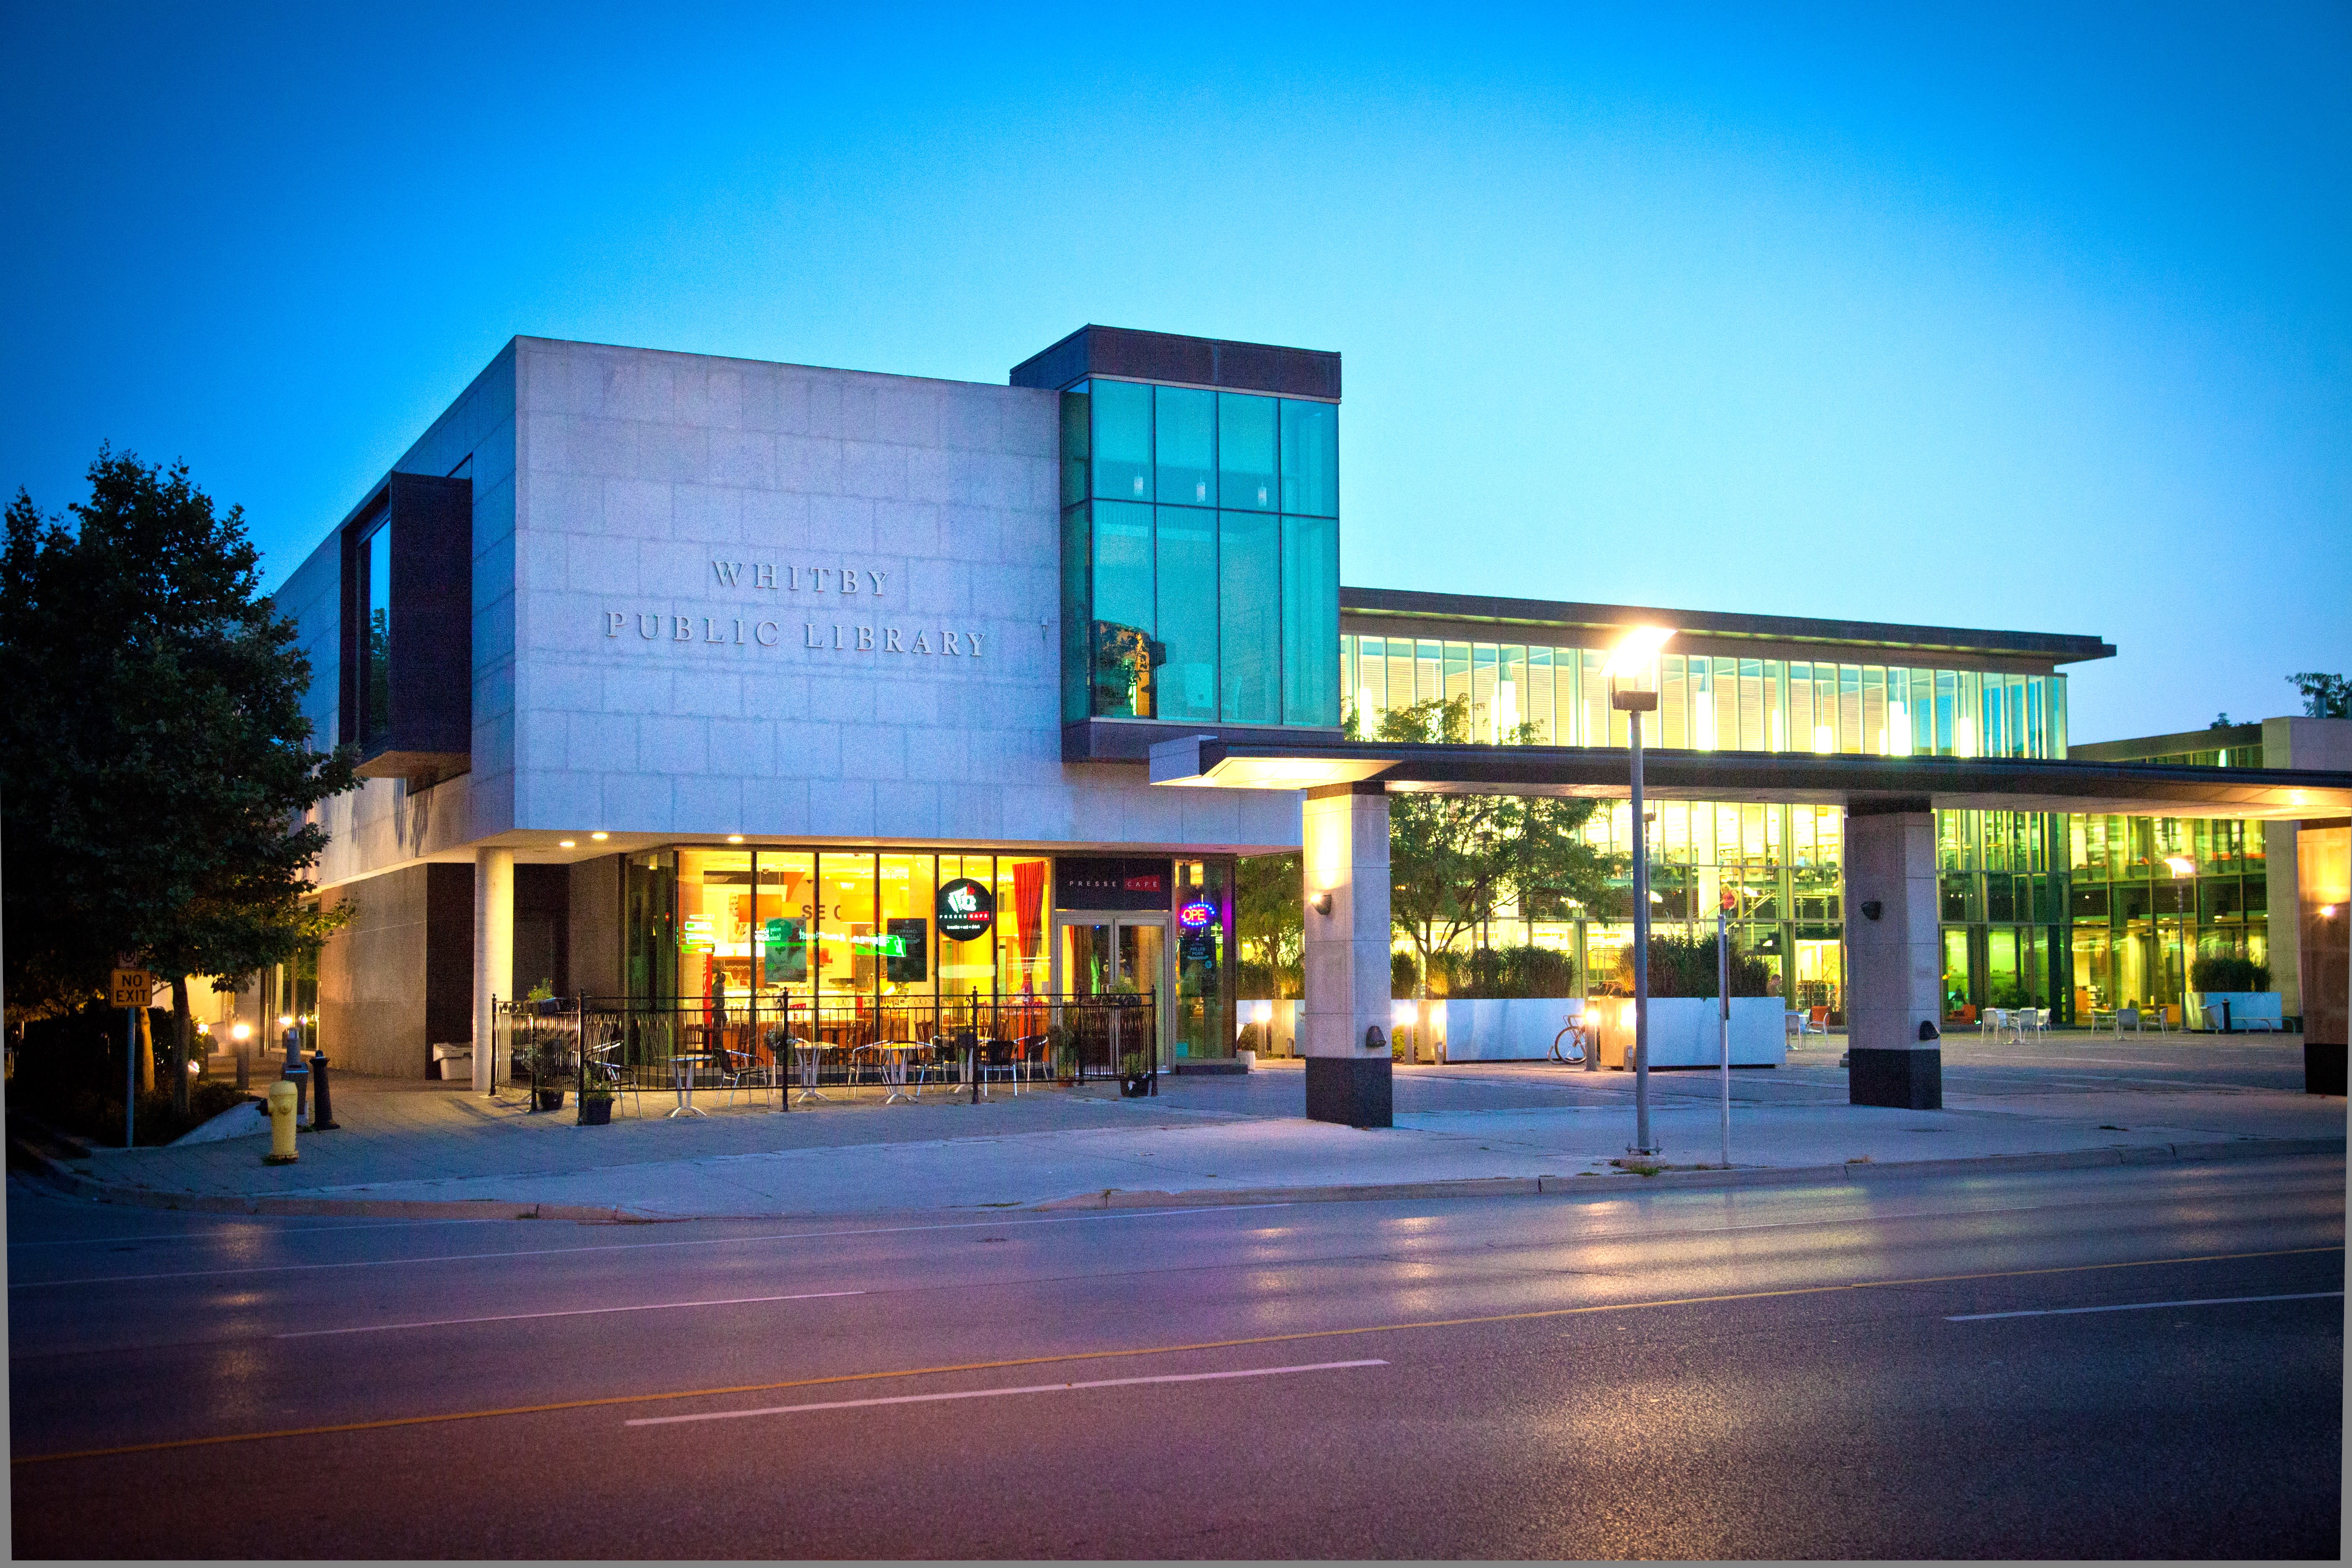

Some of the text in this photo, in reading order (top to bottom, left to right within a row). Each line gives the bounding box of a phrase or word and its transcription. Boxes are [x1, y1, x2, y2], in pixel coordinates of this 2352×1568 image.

[712, 560, 889, 596] WHITBY
[606, 611, 986, 657] PUBLIC LIBRARY
[122, 975, 142, 987] NO
[116, 989, 147, 1002] EXIT
